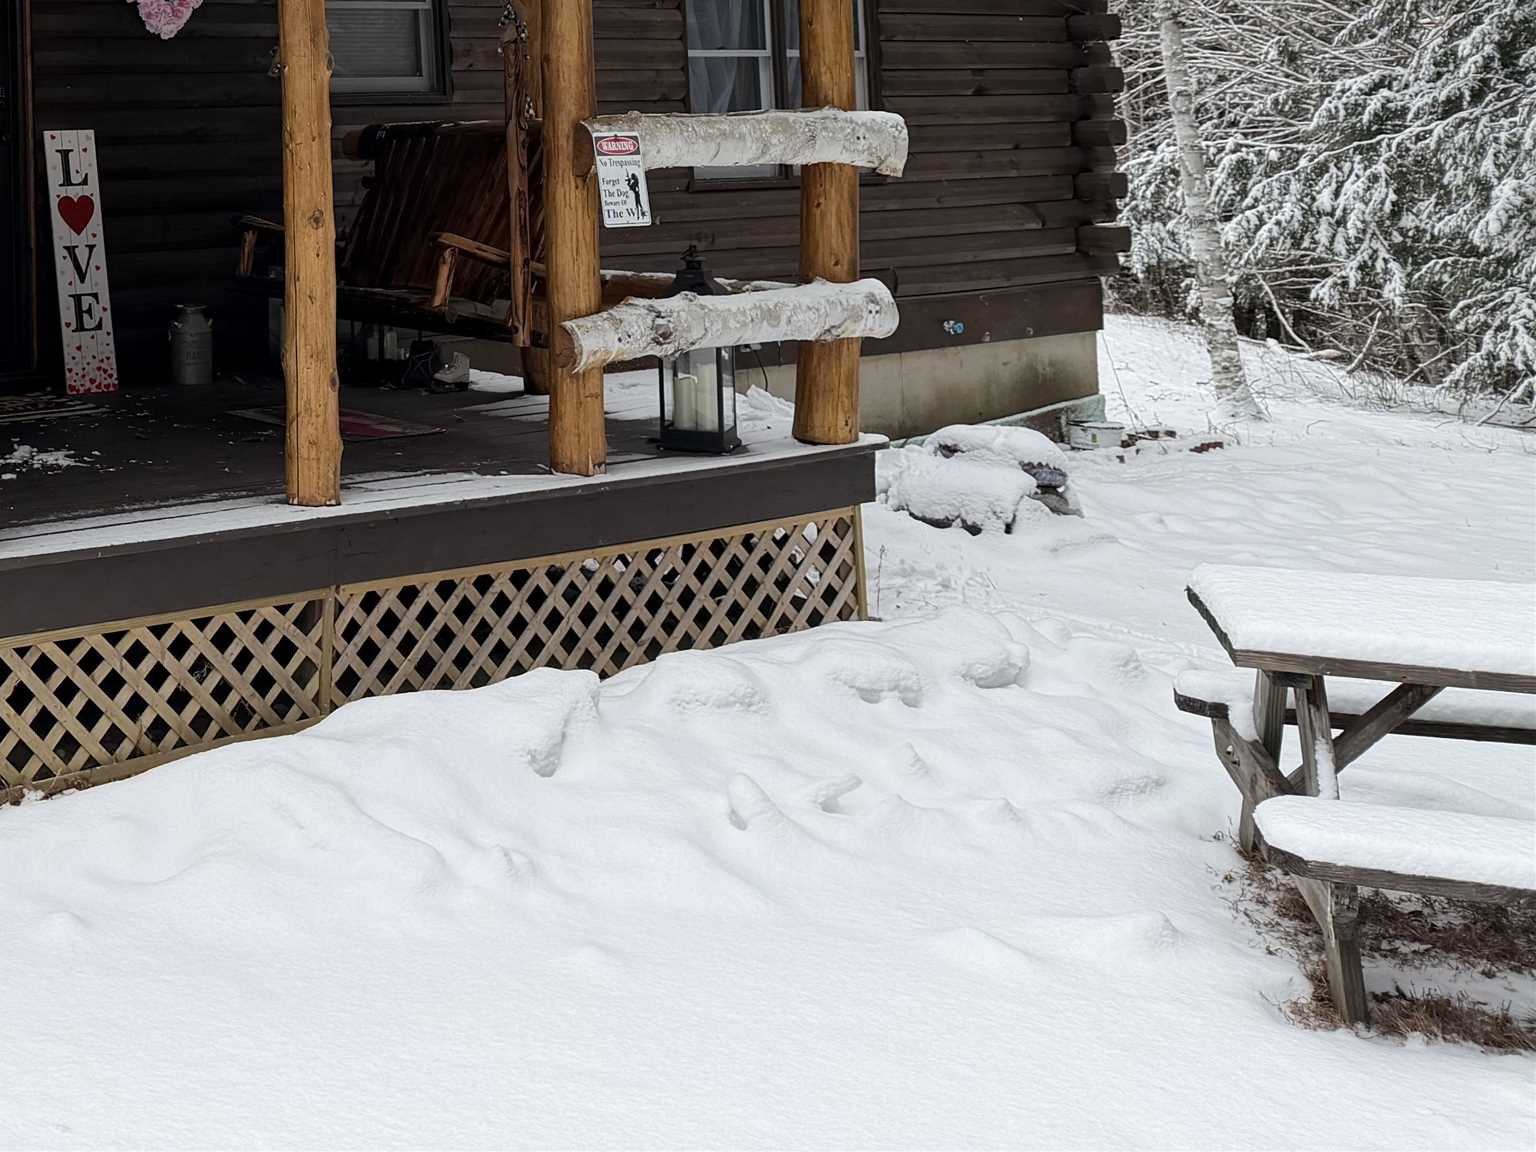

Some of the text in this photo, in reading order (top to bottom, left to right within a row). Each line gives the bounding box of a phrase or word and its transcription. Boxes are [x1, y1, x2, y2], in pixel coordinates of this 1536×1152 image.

[601, 141, 634, 150] WARNING
[599, 158, 640, 168] No Trespassing
[602, 177, 620, 186] Forget
[603, 188, 630, 199] The Dog
[606, 208, 624, 219] The
